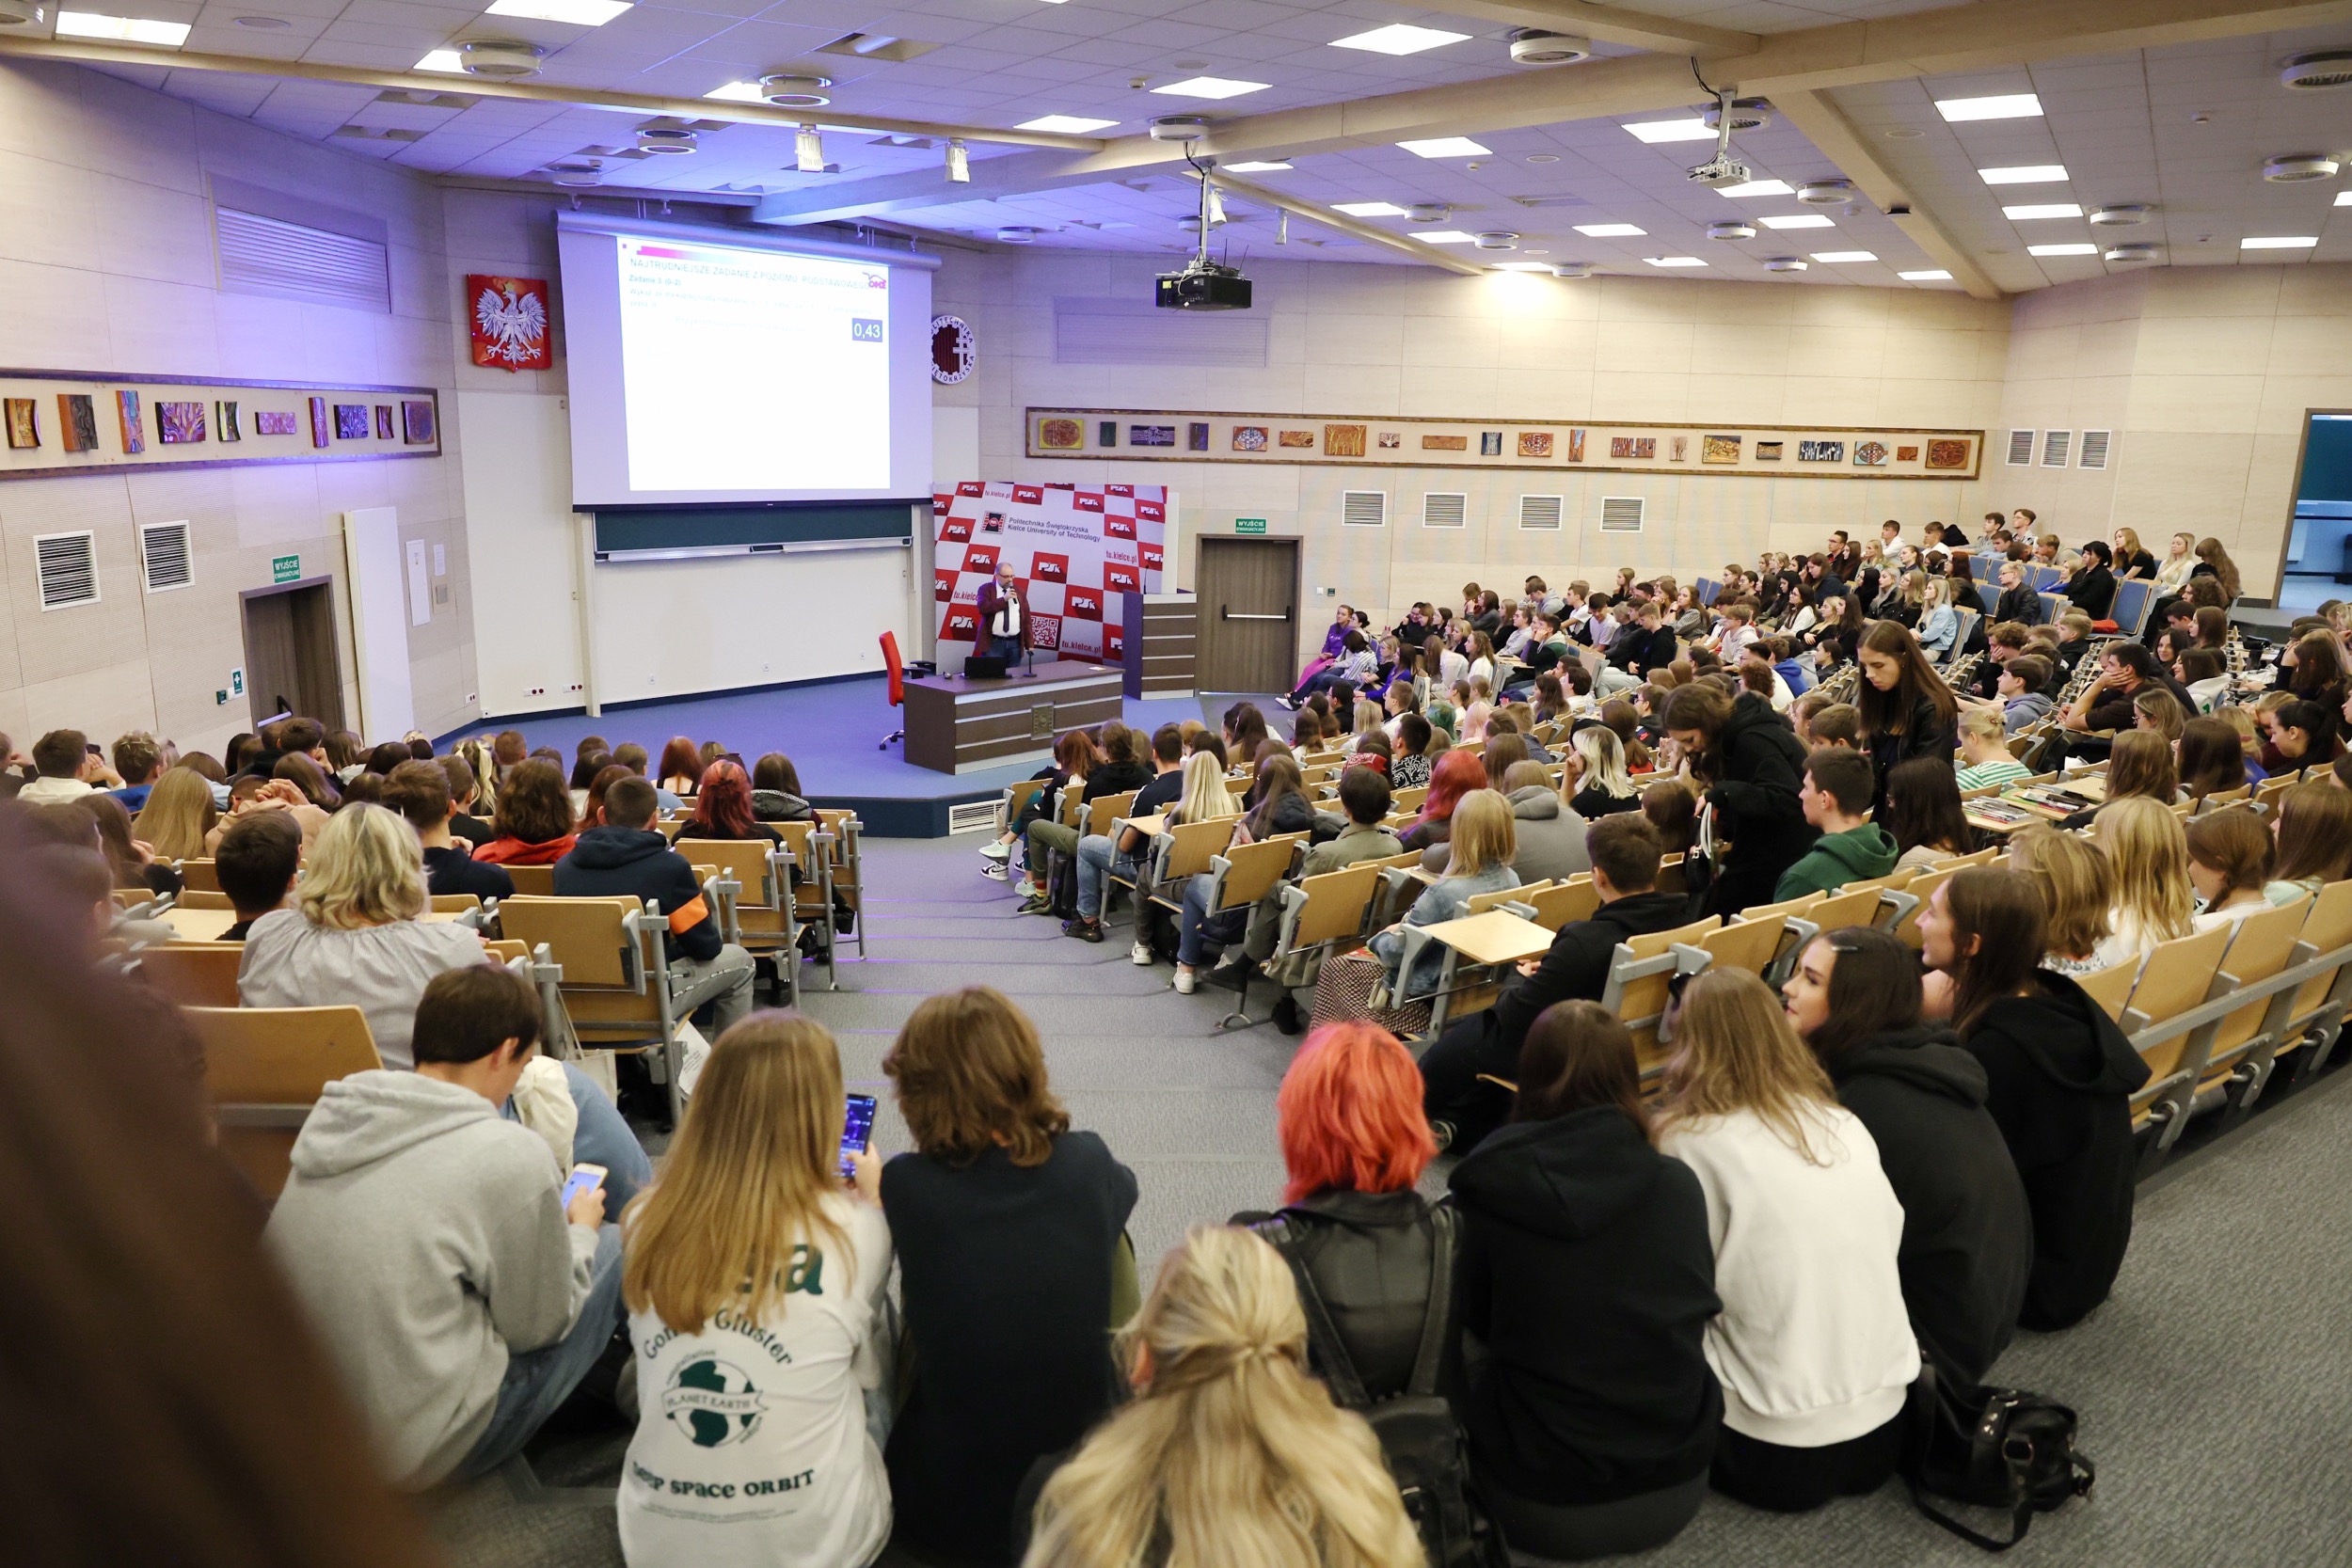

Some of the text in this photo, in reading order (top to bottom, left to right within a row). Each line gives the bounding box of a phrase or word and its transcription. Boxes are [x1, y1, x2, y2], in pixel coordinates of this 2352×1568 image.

[630, 258, 710, 274] NAJTRUDNIEJSZE
[713, 266, 750, 279] ZADANIE
[753, 271, 758, 279] Z
[760, 272, 798, 283] POZIOMU
[628, 275, 656, 284] Zadanie
[853, 323, 881, 340] 0,43
[984, 490, 1011, 499] tu.kielce.pl
[1009, 516, 1089, 533] Politechnika Świętokrzyska
[1008, 524, 1025, 532] Kielce
[1026, 526, 1057, 537] University
[1067, 531, 1101, 544] Technology
[1105, 550, 1136, 563] tu.kielce.pl
[274, 560, 298, 571] WYJŚCIE
[1062, 641, 1101, 654] tu.kielce.pl
[710, 1397, 751, 1409] EARTH
[743, 1468, 815, 1497] ORBIT
